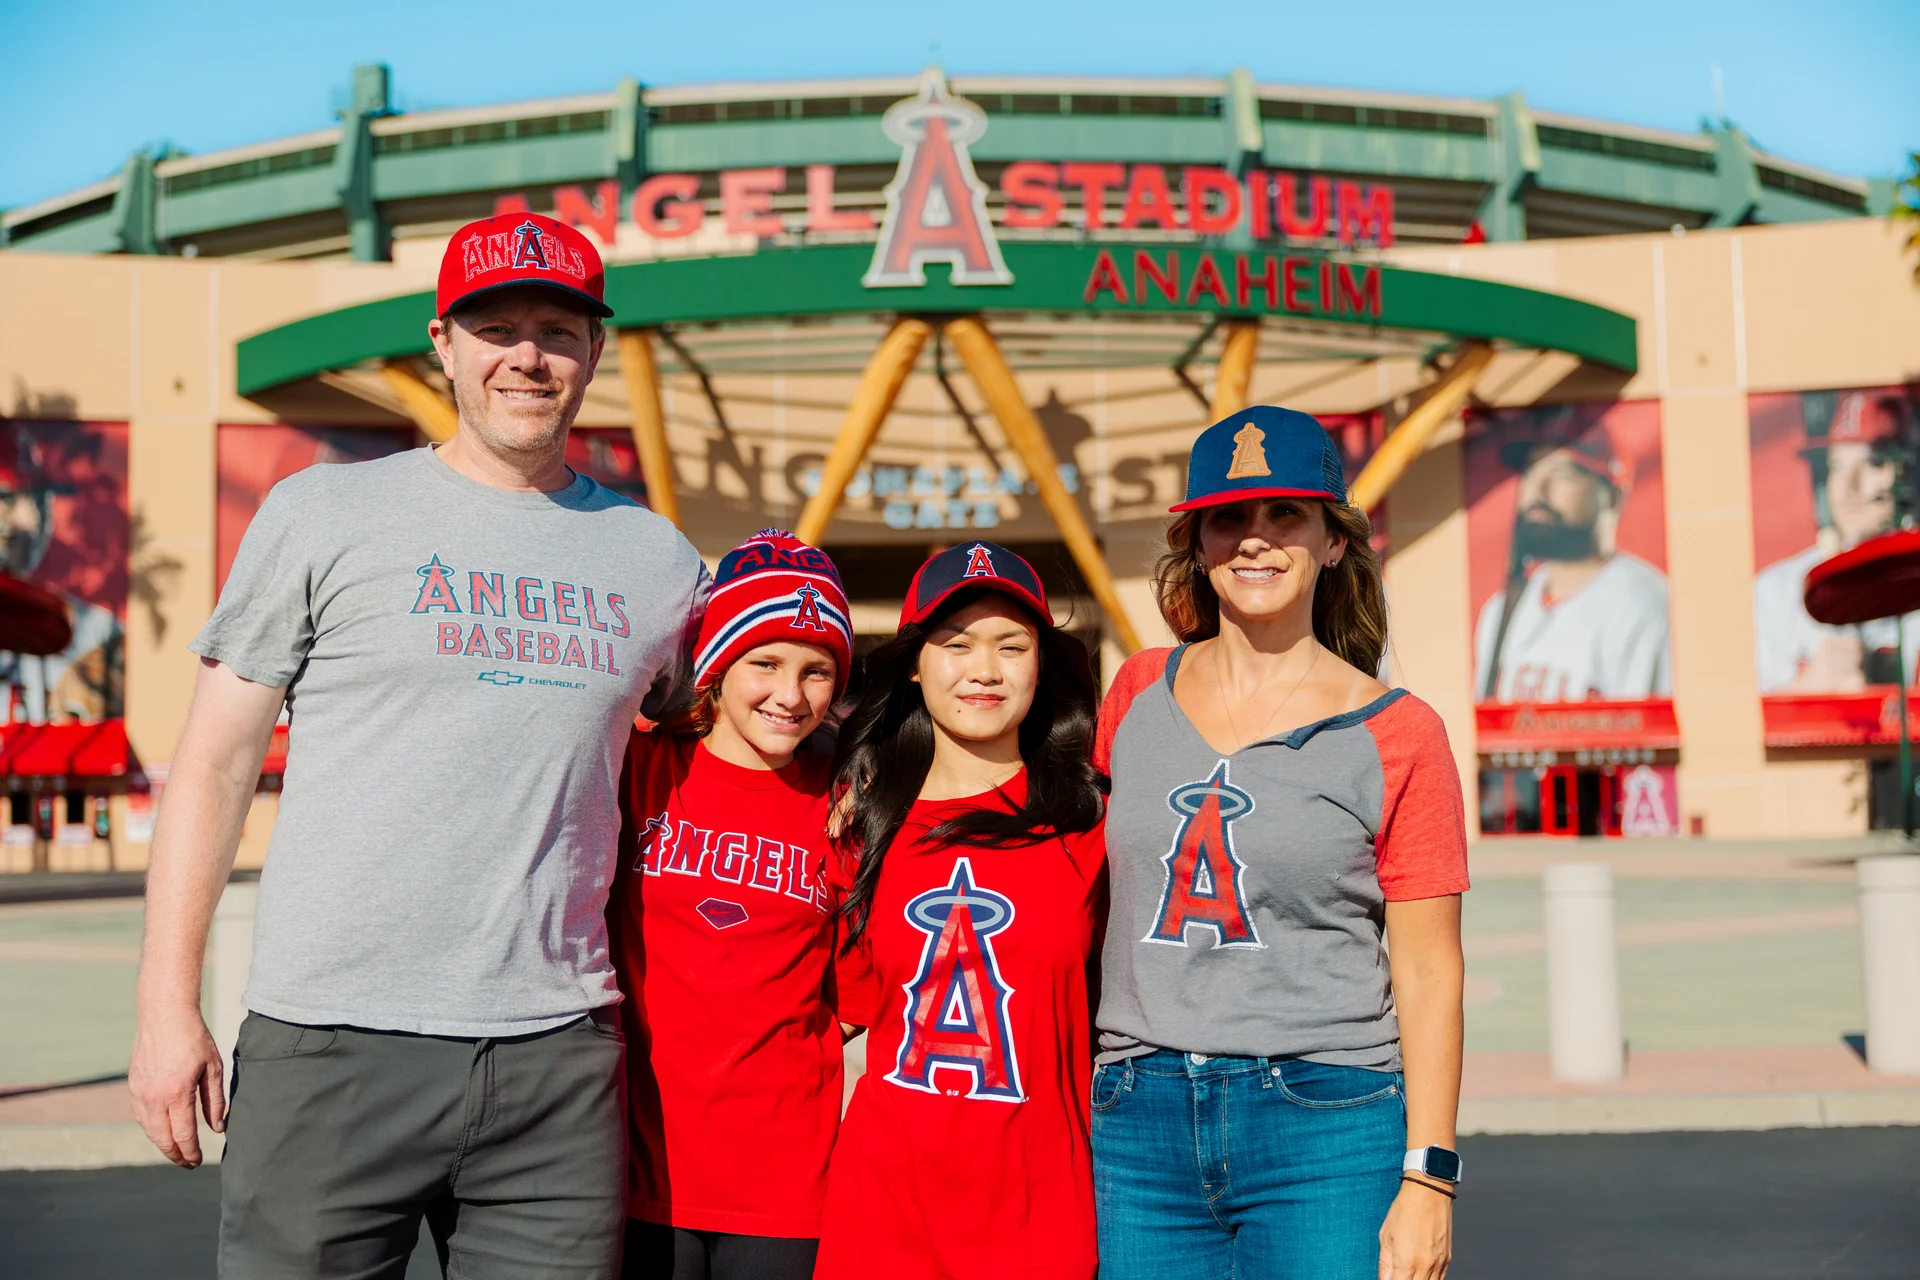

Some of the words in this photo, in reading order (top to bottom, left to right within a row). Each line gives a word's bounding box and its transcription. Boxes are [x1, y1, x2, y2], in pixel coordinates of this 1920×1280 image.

[861, 67, 1015, 288] A
[1002, 161, 1394, 249] STADIUM
[512, 220, 550, 269] A
[1083, 249, 1384, 318] ANAHEIM
[963, 543, 998, 578] A
[408, 551, 632, 640] ANGELS
[789, 581, 827, 632] A
[436, 621, 622, 677] BASEBALL
[528, 677, 588, 690] CHEVROLET
[1140, 758, 1268, 950] A
[883, 856, 1028, 1104] A
